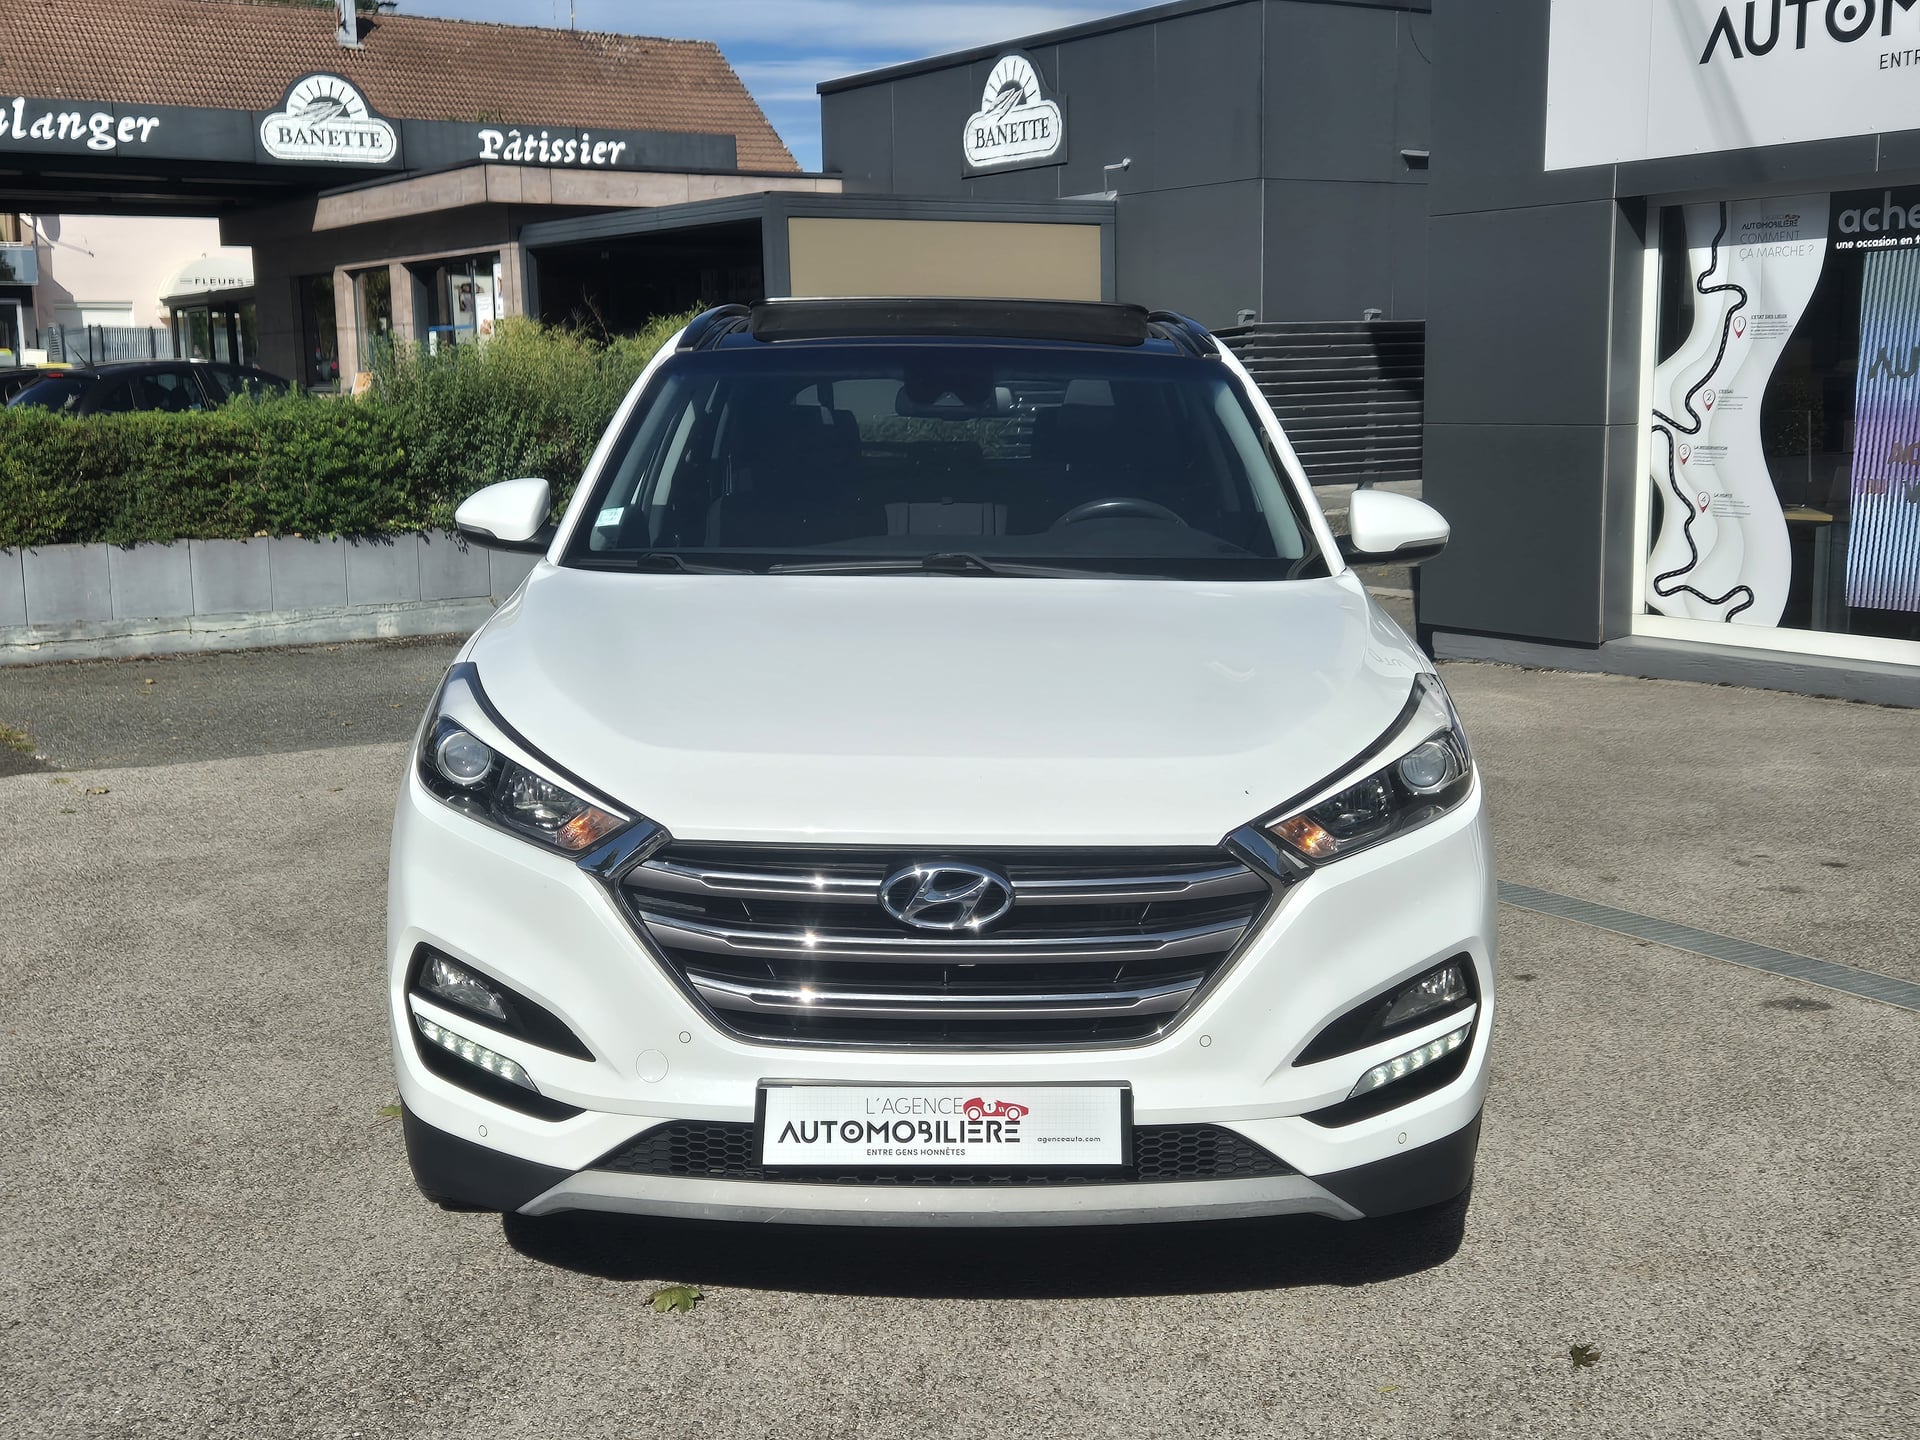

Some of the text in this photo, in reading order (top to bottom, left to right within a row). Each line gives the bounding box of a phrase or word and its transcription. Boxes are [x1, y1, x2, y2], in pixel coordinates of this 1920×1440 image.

[279, 127, 382, 149] BANETTE
[975, 117, 1051, 150] BANETTE
[477, 129, 626, 165] Pâtissier
[1740, 230, 1800, 245] COMMENT
[1836, 241, 1854, 250] une
[1856, 235, 1898, 249] occasion
[1899, 237, 1913, 246] en
[1739, 244, 1815, 262] ÇA MARCHE ?
[194, 276, 244, 286] FLEURS
[987, 1103, 992, 1111] 1
[1037, 1136, 1101, 1144] agenceauto.com
[866, 1146, 966, 1156] ENTRE GENS HONNÊTES
